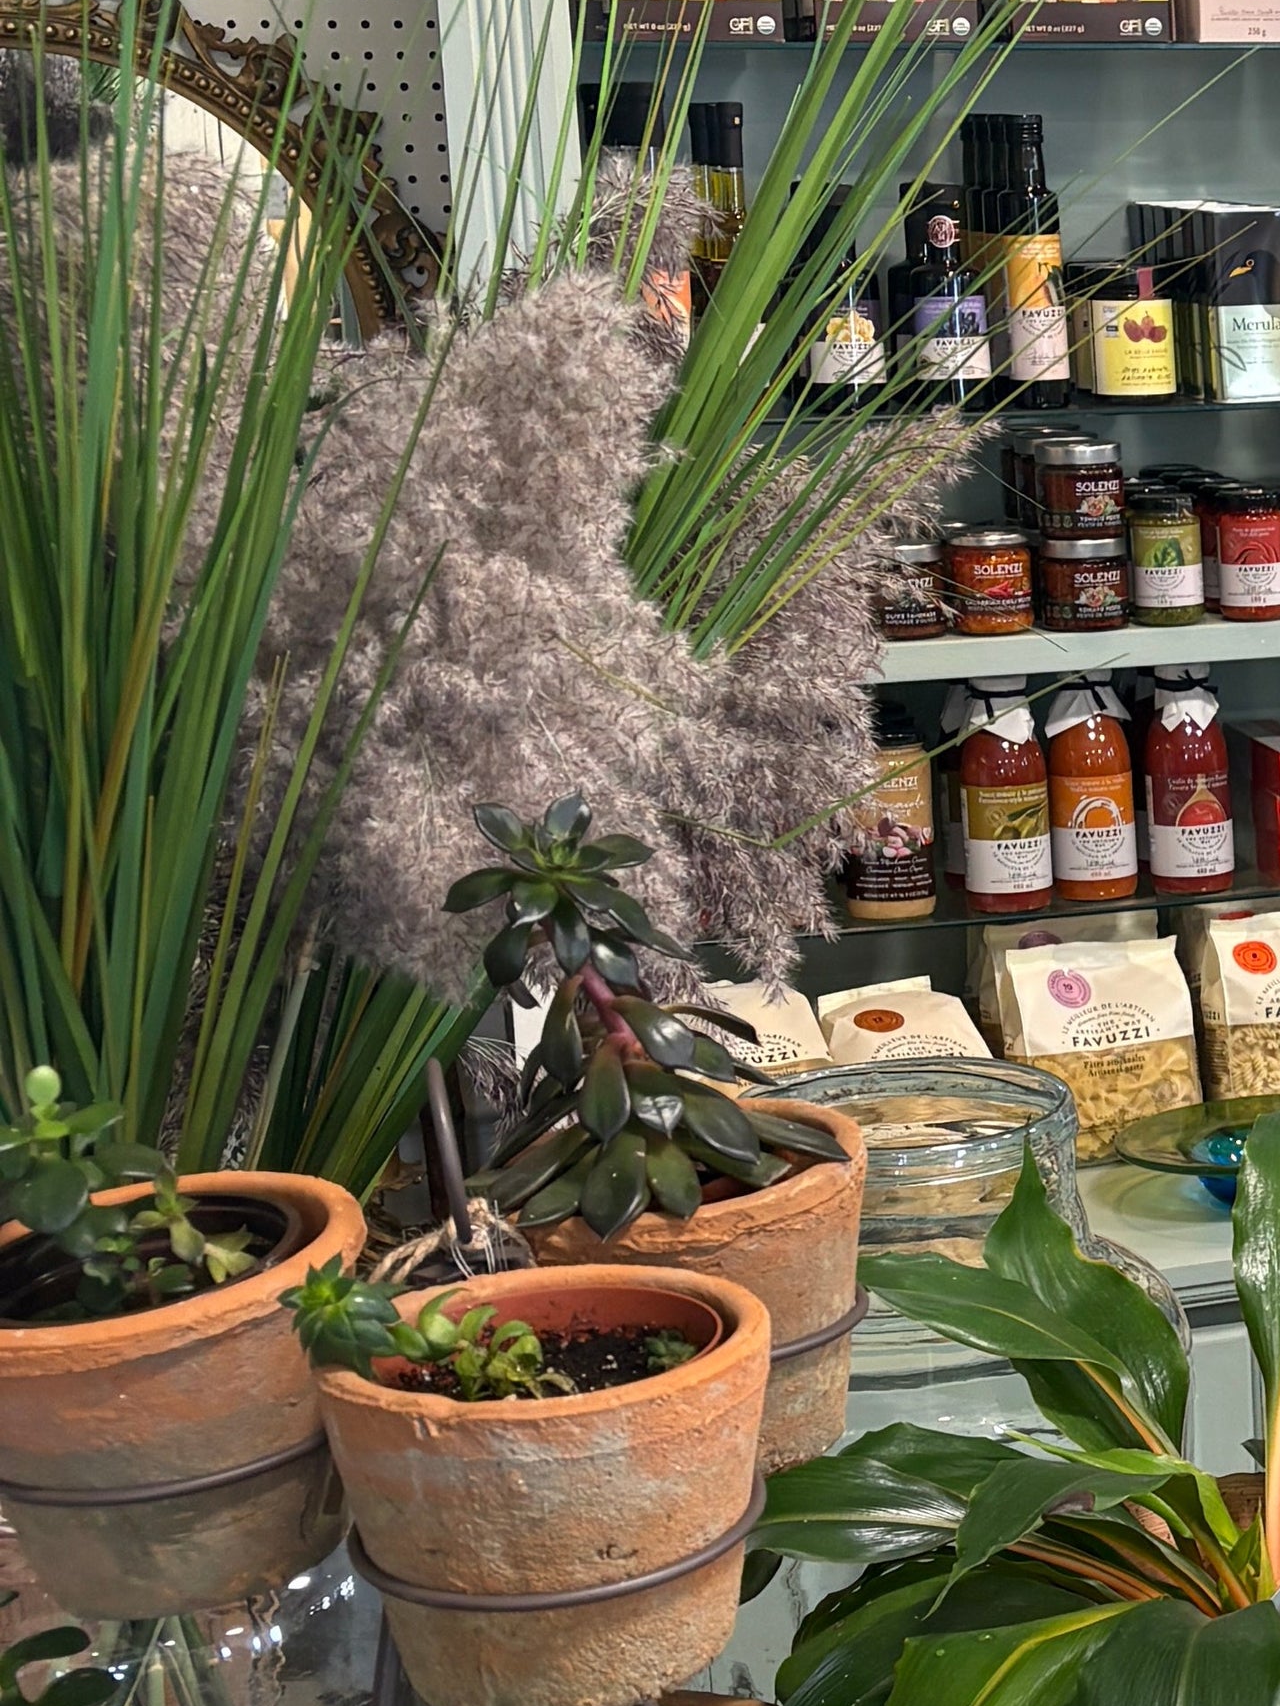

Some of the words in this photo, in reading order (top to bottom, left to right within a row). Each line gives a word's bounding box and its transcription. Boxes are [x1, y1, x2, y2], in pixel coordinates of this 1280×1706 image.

[1075, 480, 1120, 493] SOLENZI
[973, 562, 1023, 576] SOLENZI
[1074, 570, 1121, 584] SOLENZI
[1075, 829, 1122, 839] FAVUZZI
[1181, 826, 1225, 837] FAVUZZI
[997, 839, 1042, 851] FAVUZZI
[1066, 1006, 1098, 1026] MEILLEUR
[1101, 1002, 1113, 1011] DE
[1097, 1019, 1115, 1028] THE
[1072, 1026, 1150, 1047] FAVUZZI
